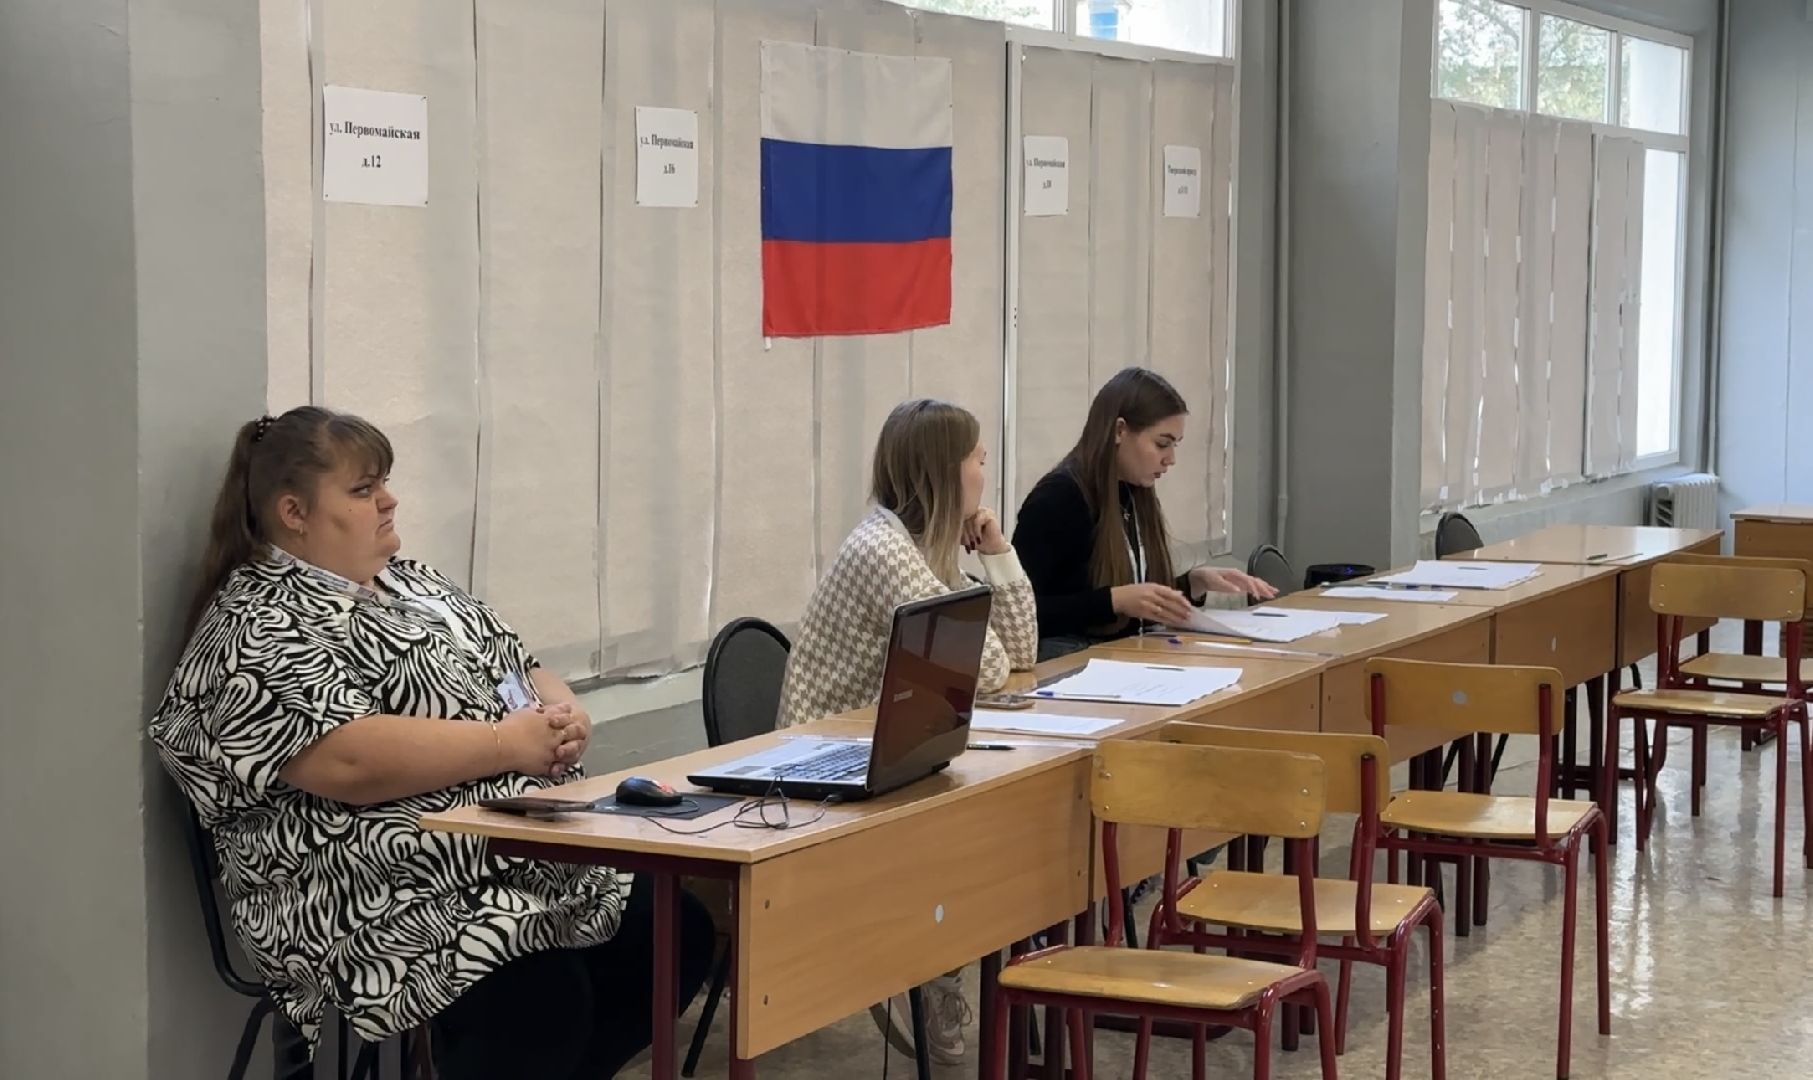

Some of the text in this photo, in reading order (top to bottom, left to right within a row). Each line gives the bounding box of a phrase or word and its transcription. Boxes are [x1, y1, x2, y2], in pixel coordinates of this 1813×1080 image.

[329, 121, 420, 140] ул. Первомайская
[361, 154, 382, 168] д.12
